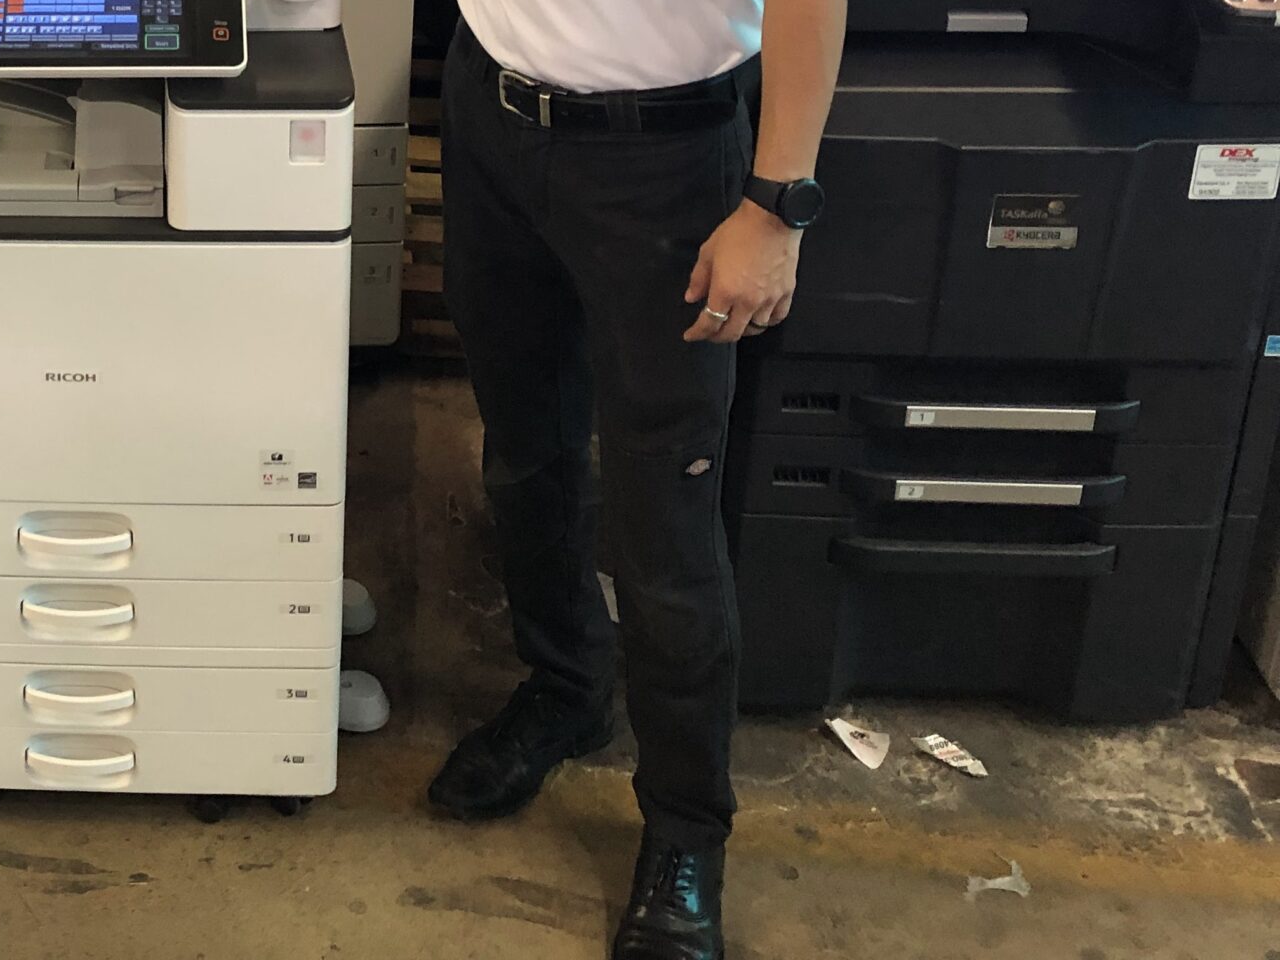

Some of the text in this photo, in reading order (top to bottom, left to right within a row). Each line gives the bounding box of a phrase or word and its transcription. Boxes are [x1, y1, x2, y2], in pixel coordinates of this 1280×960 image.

[1220, 147, 1256, 158] DEX
[45, 372, 97, 382] RICOH
[288, 603, 297, 614] 2
[286, 688, 294, 699] 3
